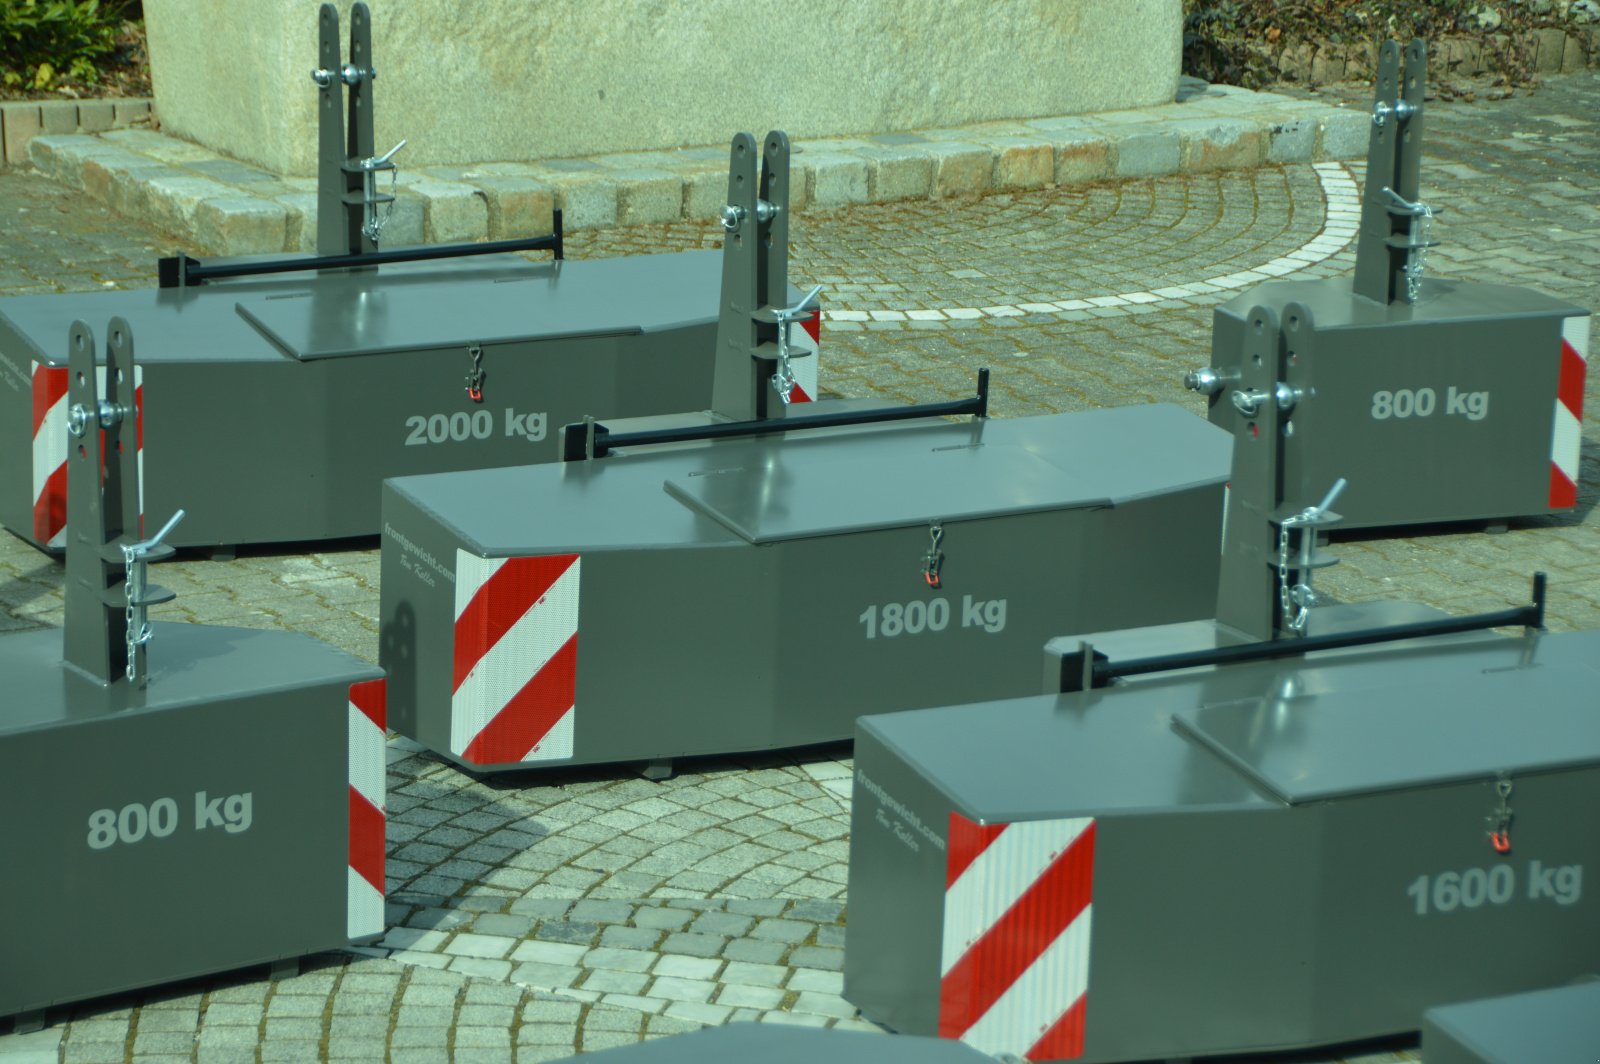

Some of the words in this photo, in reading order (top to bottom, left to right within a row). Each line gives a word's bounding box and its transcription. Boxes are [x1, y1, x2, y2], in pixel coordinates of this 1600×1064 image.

[404, 410, 493, 446] 2000
[505, 408, 547, 441] kg
[1371, 388, 1436, 420] 800
[1446, 386, 1489, 421] kg
[384, 522, 455, 583] frontgewicht.com
[859, 597, 950, 639] 1800
[962, 594, 1007, 633] kg
[87, 797, 178, 849] 800
[195, 791, 252, 834] kg
[857, 768, 945, 851] frontgewicht.com
[1407, 863, 1515, 915] 1600
[1528, 860, 1583, 905] kg
